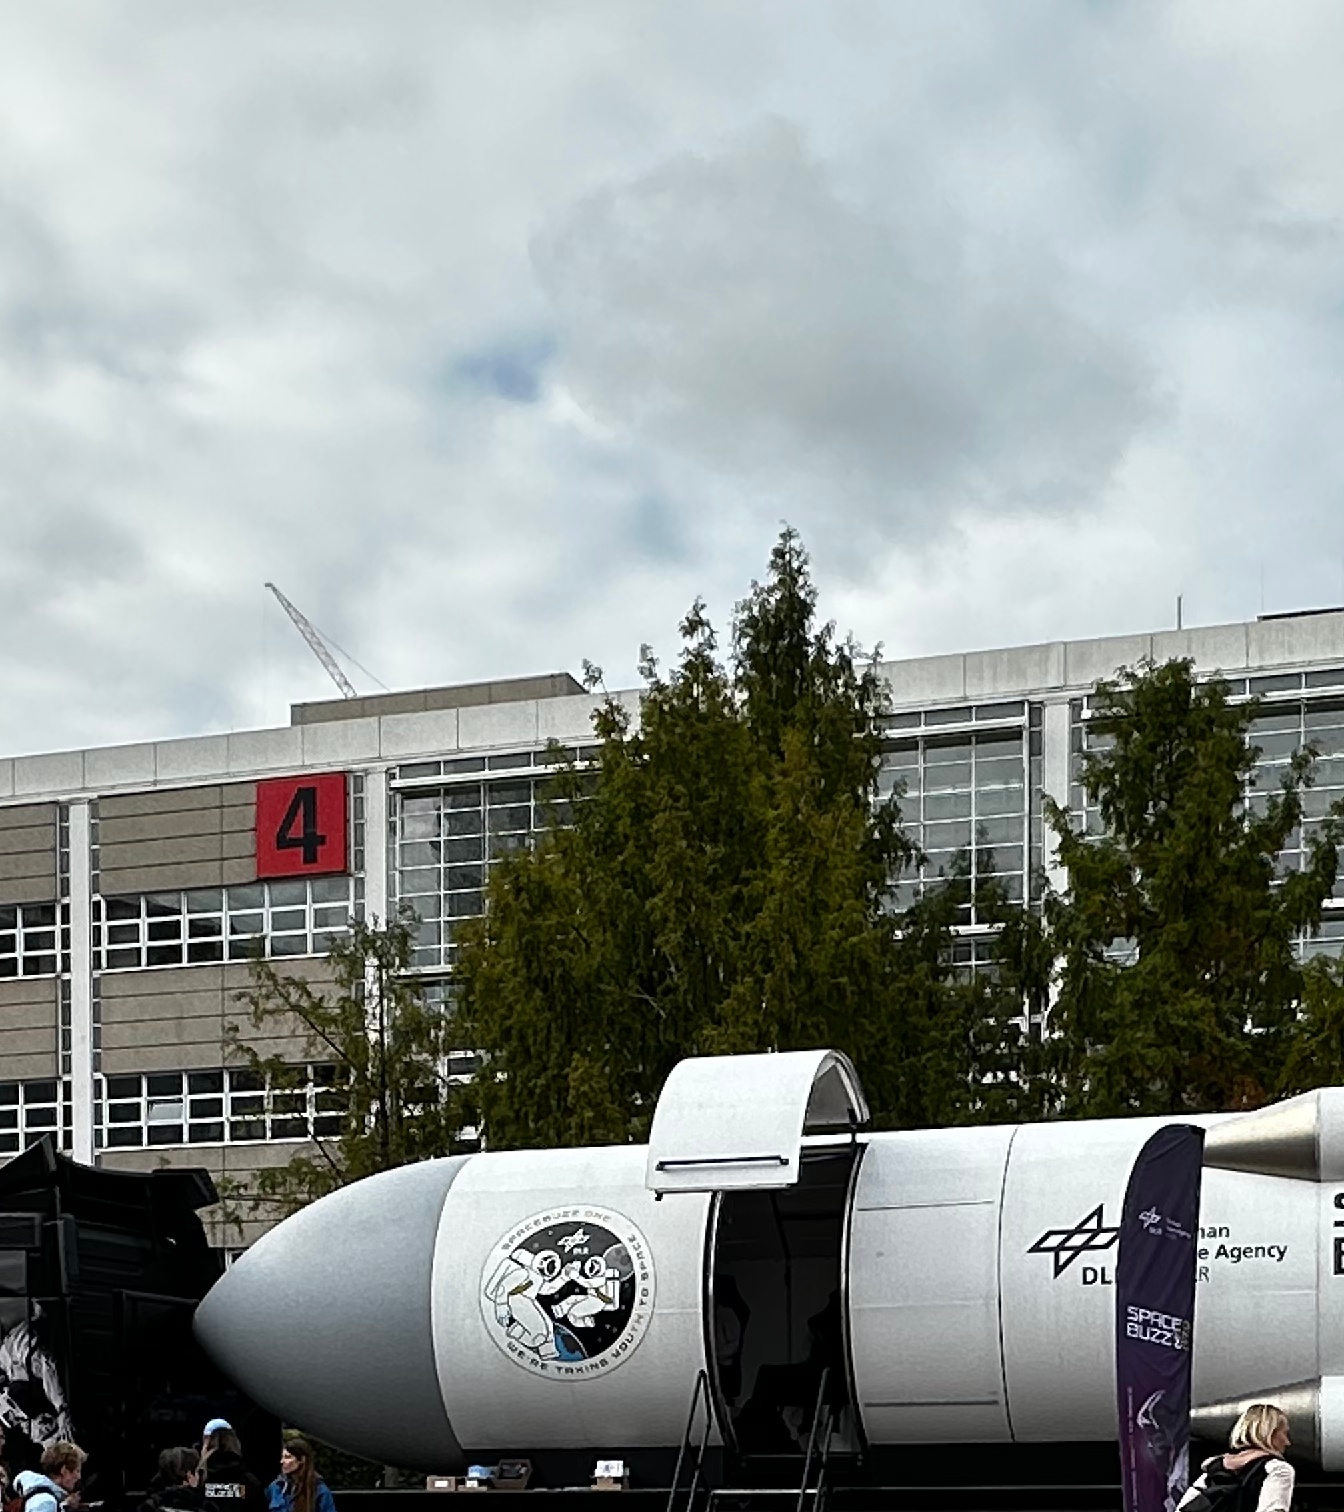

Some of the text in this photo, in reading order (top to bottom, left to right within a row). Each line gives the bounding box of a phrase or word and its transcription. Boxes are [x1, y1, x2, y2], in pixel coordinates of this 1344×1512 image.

[276, 786, 327, 864] 4
[1214, 1243, 1289, 1264] Agency
[1082, 1266, 1114, 1285] DL
[1126, 1305, 1183, 1331] SPACE
